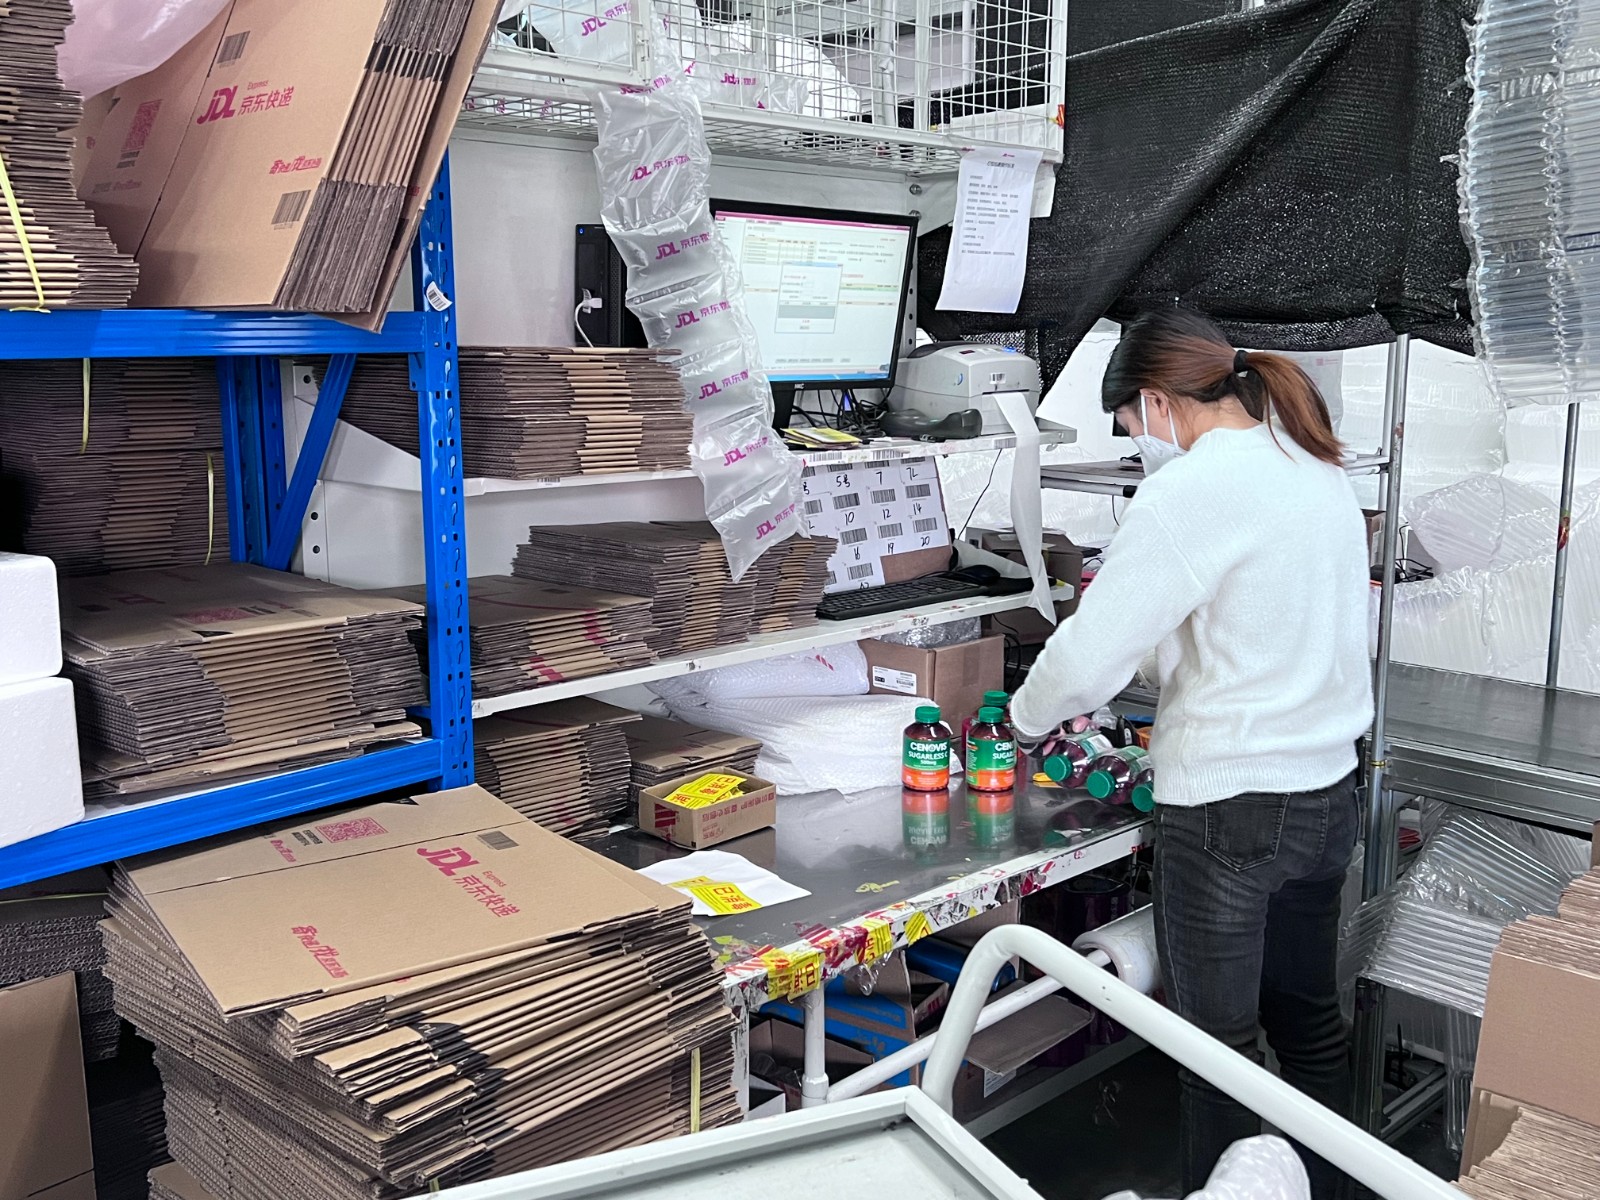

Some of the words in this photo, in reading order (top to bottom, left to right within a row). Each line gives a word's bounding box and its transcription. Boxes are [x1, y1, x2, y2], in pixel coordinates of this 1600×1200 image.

[581, 16, 607, 36] JDL
[196, 85, 239, 125] JDL
[238, 86, 295, 116] 京东快递
[655, 242, 681, 260] JDL
[675, 310, 700, 329] JDL
[699, 381, 722, 400] JDL
[723, 447, 747, 467] JDL
[875, 471, 883, 486] 7
[844, 511, 855, 526] 10
[882, 508, 892, 521] 12
[756, 520, 777, 540] JDL
[920, 535, 931, 547] 20
[908, 750, 942, 760] SUGARLESS
[910, 741, 948, 751] CENOVIS
[416, 846, 480, 877] JDL
[453, 874, 520, 917] 京东快递
